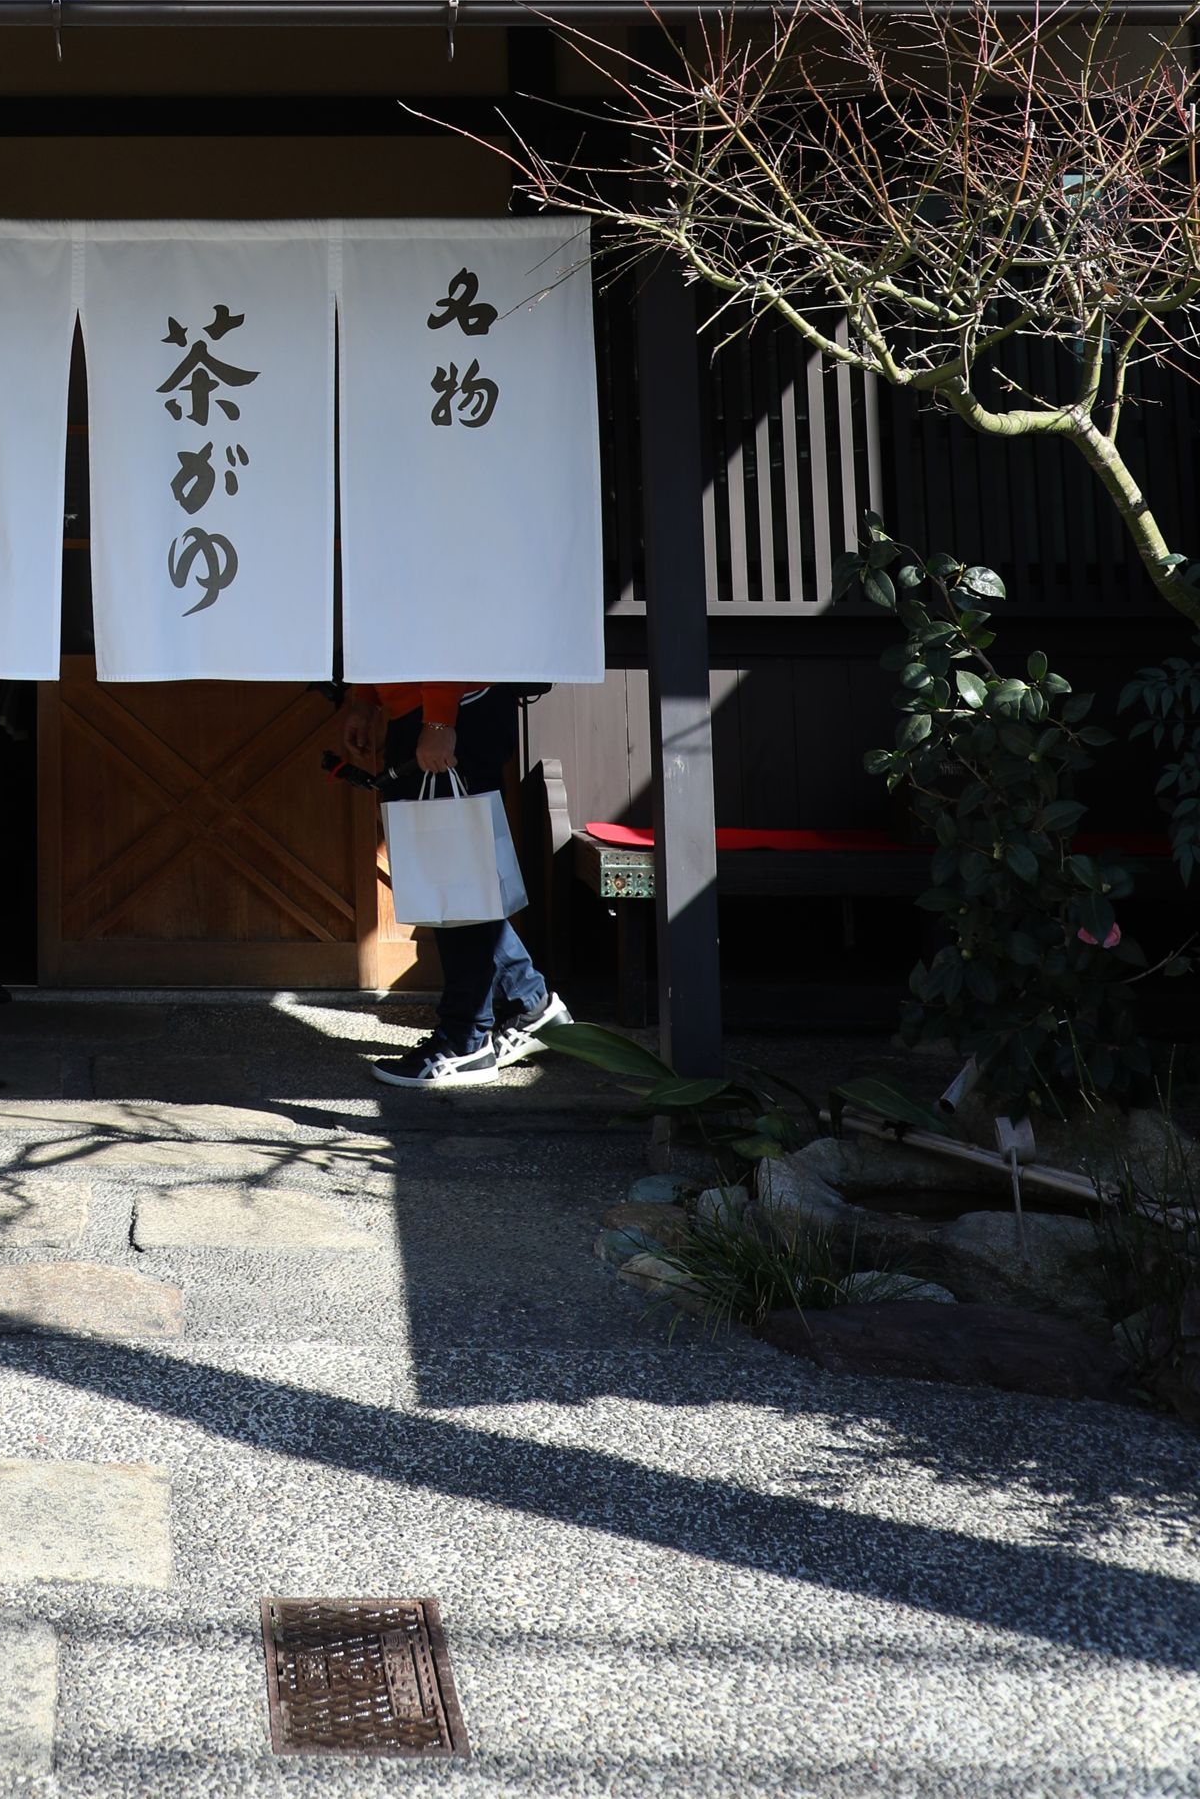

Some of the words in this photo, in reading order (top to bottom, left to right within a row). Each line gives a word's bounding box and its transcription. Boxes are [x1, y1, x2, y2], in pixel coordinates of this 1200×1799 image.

[156, 304, 261, 617] 茶がゆ
[427, 266, 499, 429] 名物
